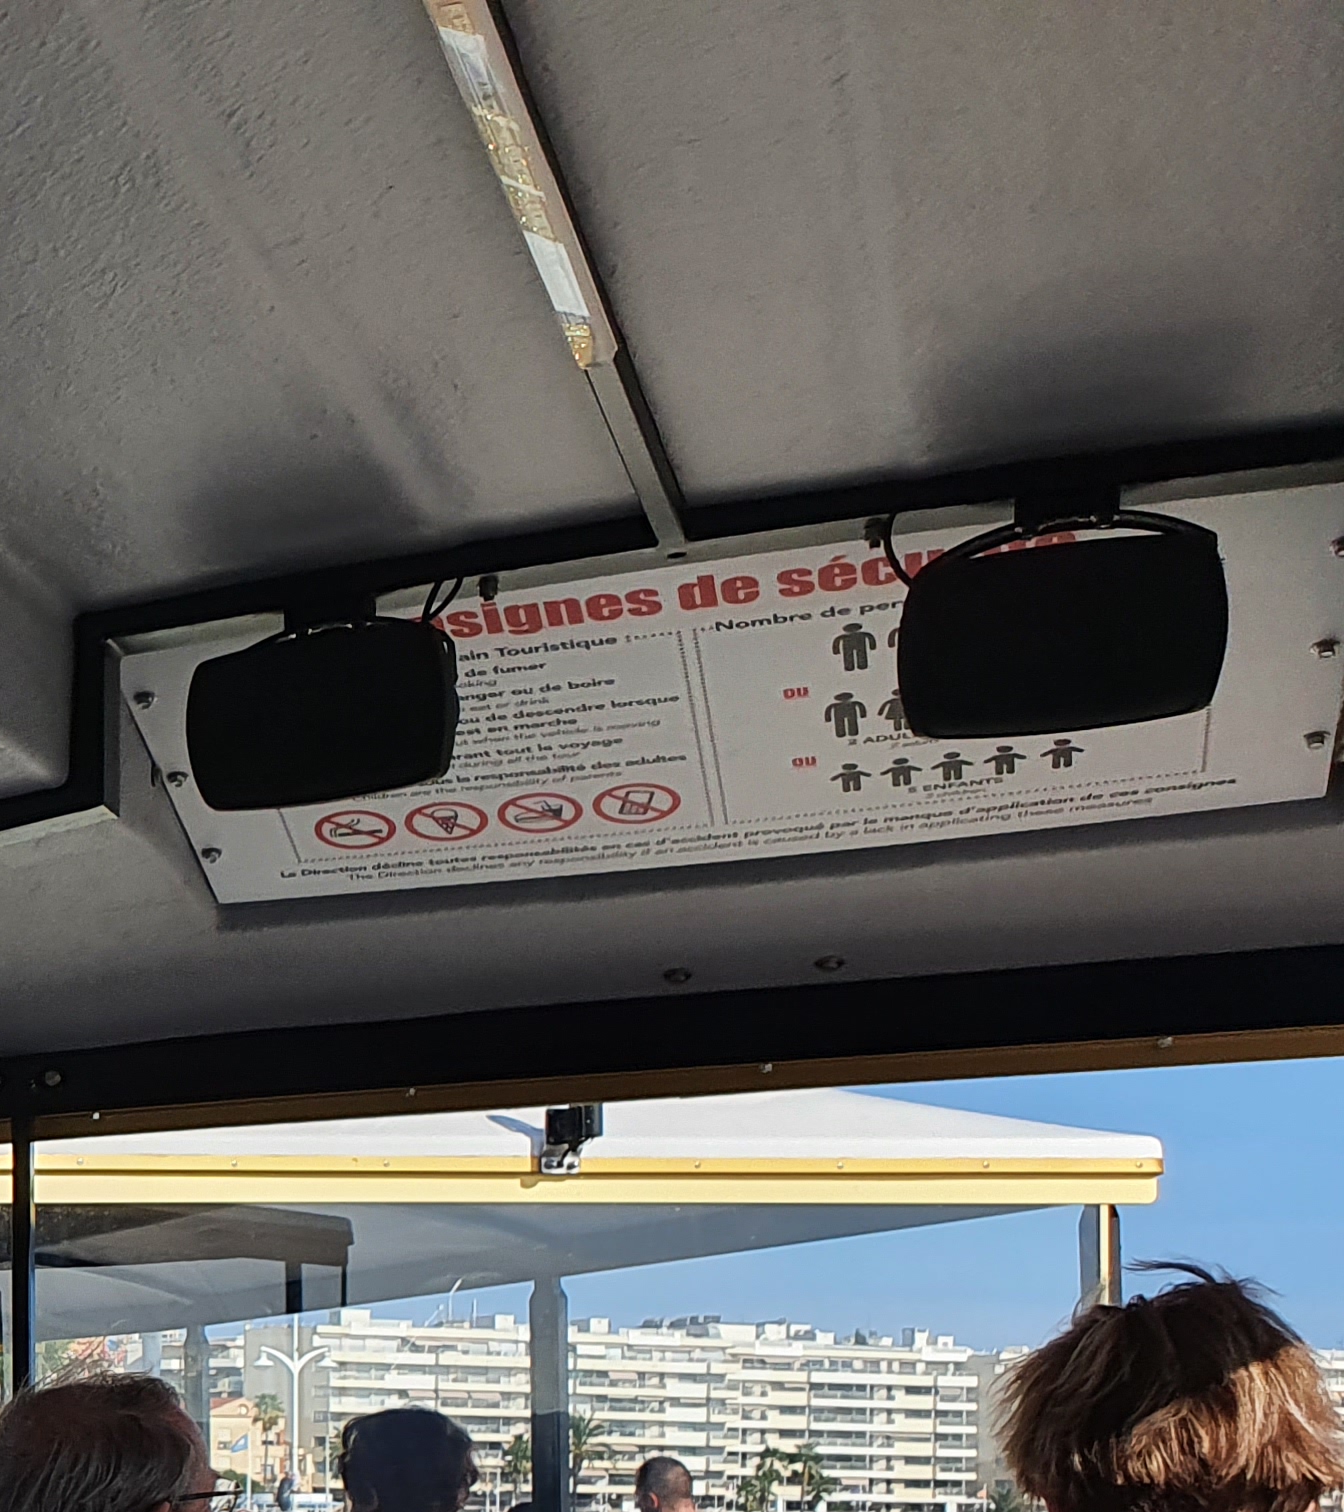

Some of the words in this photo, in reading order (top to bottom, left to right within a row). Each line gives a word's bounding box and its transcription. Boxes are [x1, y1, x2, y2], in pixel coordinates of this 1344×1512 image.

[410, 587, 663, 638] signes
[677, 574, 760, 611] de
[715, 613, 812, 632] Nombre
[820, 606, 852, 618] de
[459, 650, 489, 661] ain
[494, 637, 618, 657] Touristique
[464, 669, 487, 678] de
[493, 662, 547, 675] fumer
[539, 683, 562, 693] de
[567, 678, 615, 690] boire
[782, 685, 810, 700] ou
[486, 712, 507, 721] de
[512, 703, 605, 719] descendre
[611, 695, 680, 709] lorsque
[513, 718, 577, 731] marche
[863, 732, 912, 745] ADUL
[496, 746, 532, 756] tout
[558, 738, 623, 750] voyage
[791, 755, 816, 768] ou
[923, 776, 1003, 792] ENFANTS
[301, 865, 367, 877] Direction
